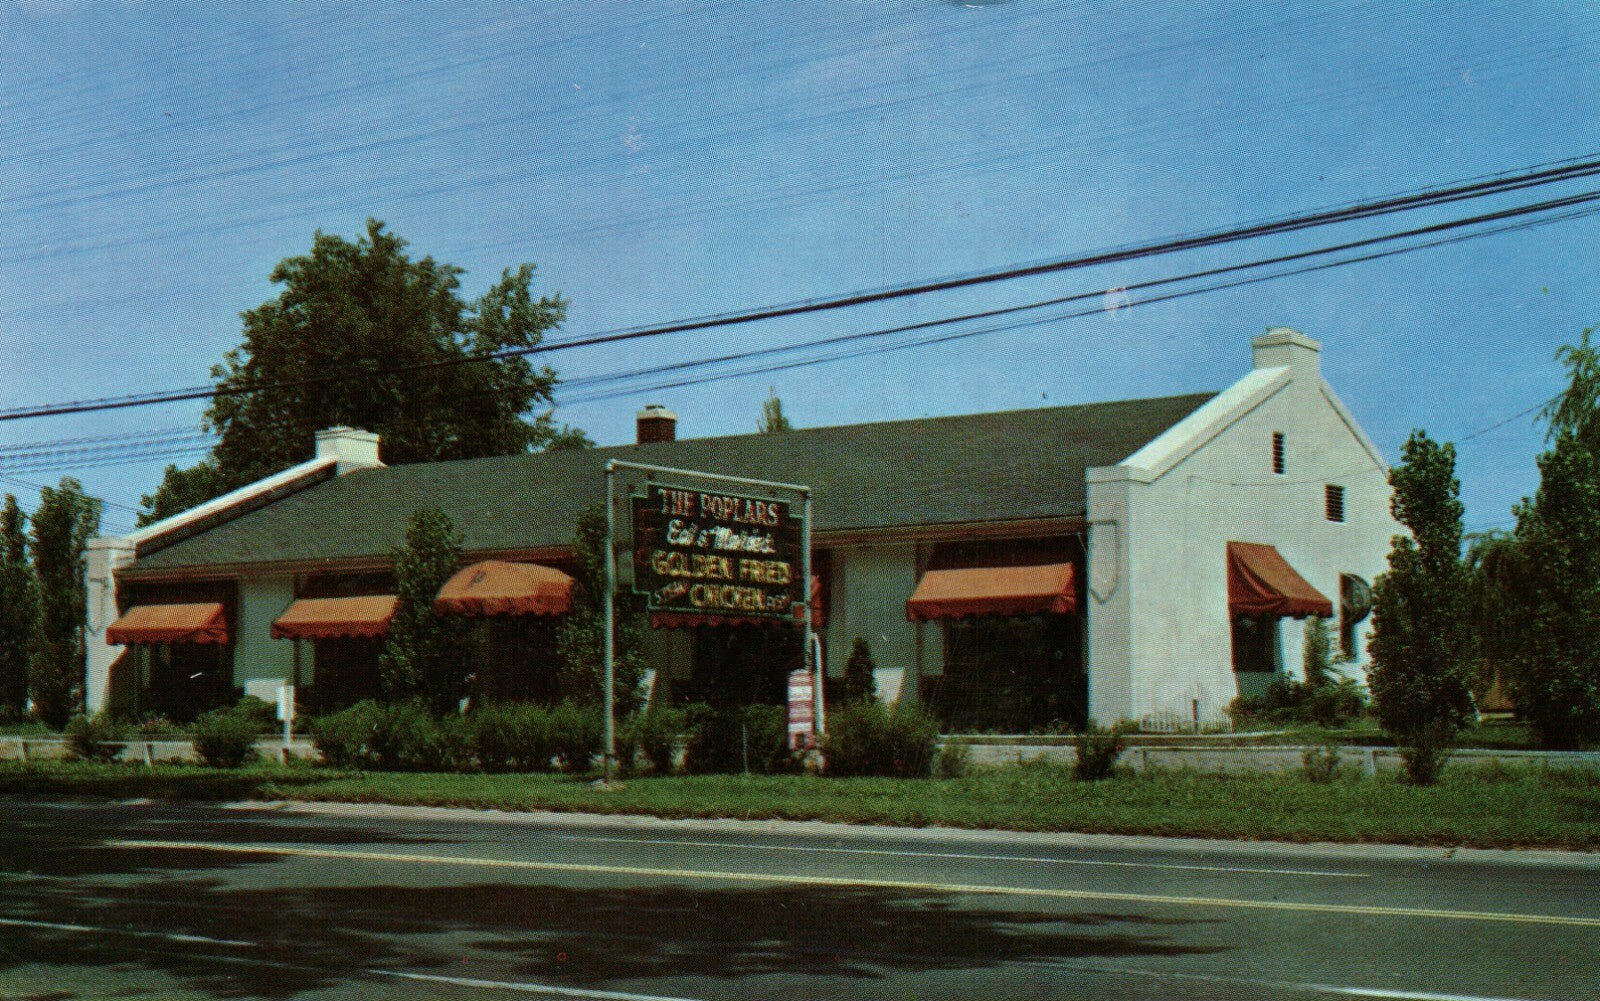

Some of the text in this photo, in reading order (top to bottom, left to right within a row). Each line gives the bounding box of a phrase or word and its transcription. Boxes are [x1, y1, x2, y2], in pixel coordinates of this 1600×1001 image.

[658, 488, 780, 526] THE POPLARS
[651, 550, 791, 585] GOLDEN FRIED
[689, 583, 766, 610] CHICKEN
